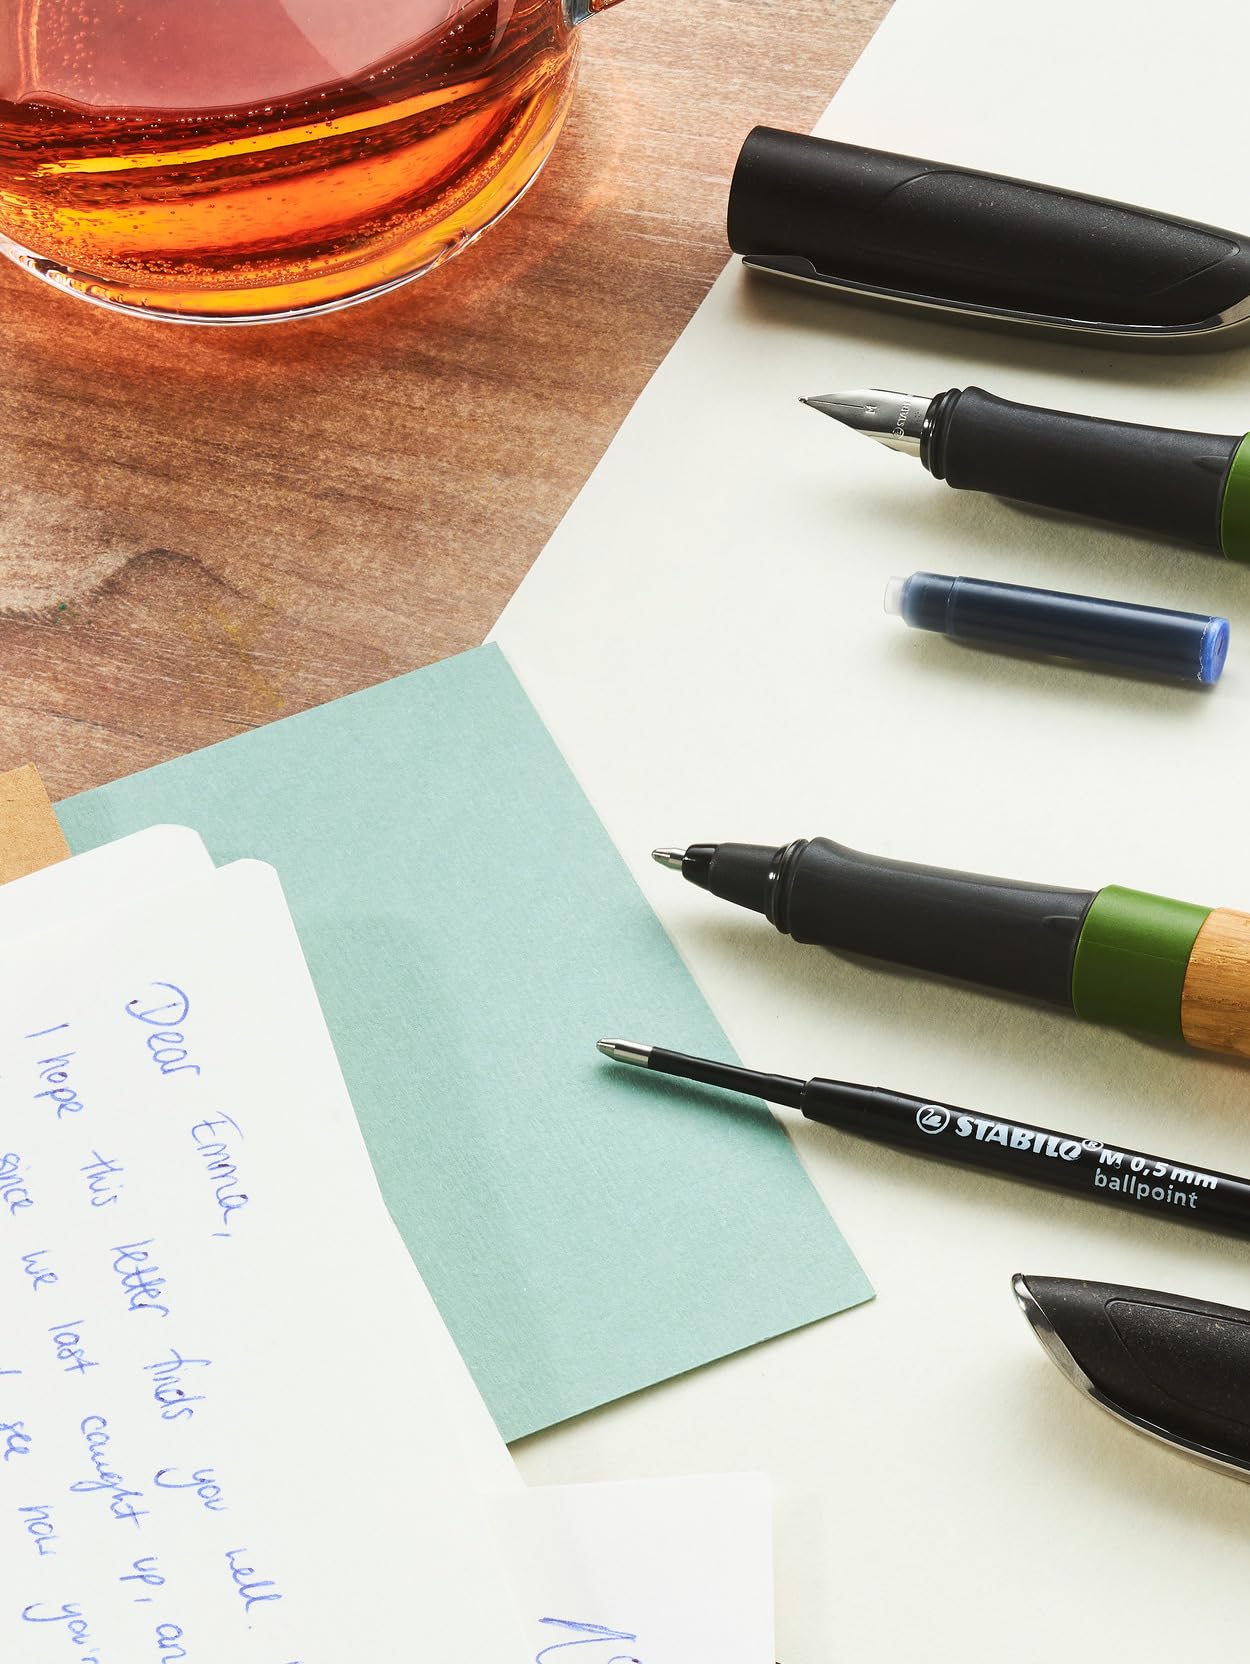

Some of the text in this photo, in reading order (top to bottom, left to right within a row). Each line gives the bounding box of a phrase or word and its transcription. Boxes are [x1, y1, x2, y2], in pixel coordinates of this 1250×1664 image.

[124, 982, 201, 1076] Dear
[33, 1051, 84, 1120] hope
[80, 1150, 125, 1207] this
[1094, 1168, 1198, 1209] ballpoint
[21, 1249, 59, 1292] we
[110, 1238, 170, 1318] letter
[48, 1319, 100, 1374] last
[143, 1348, 213, 1420] finds
[68, 1414, 150, 1528] caught
[153, 1467, 229, 1511] you
